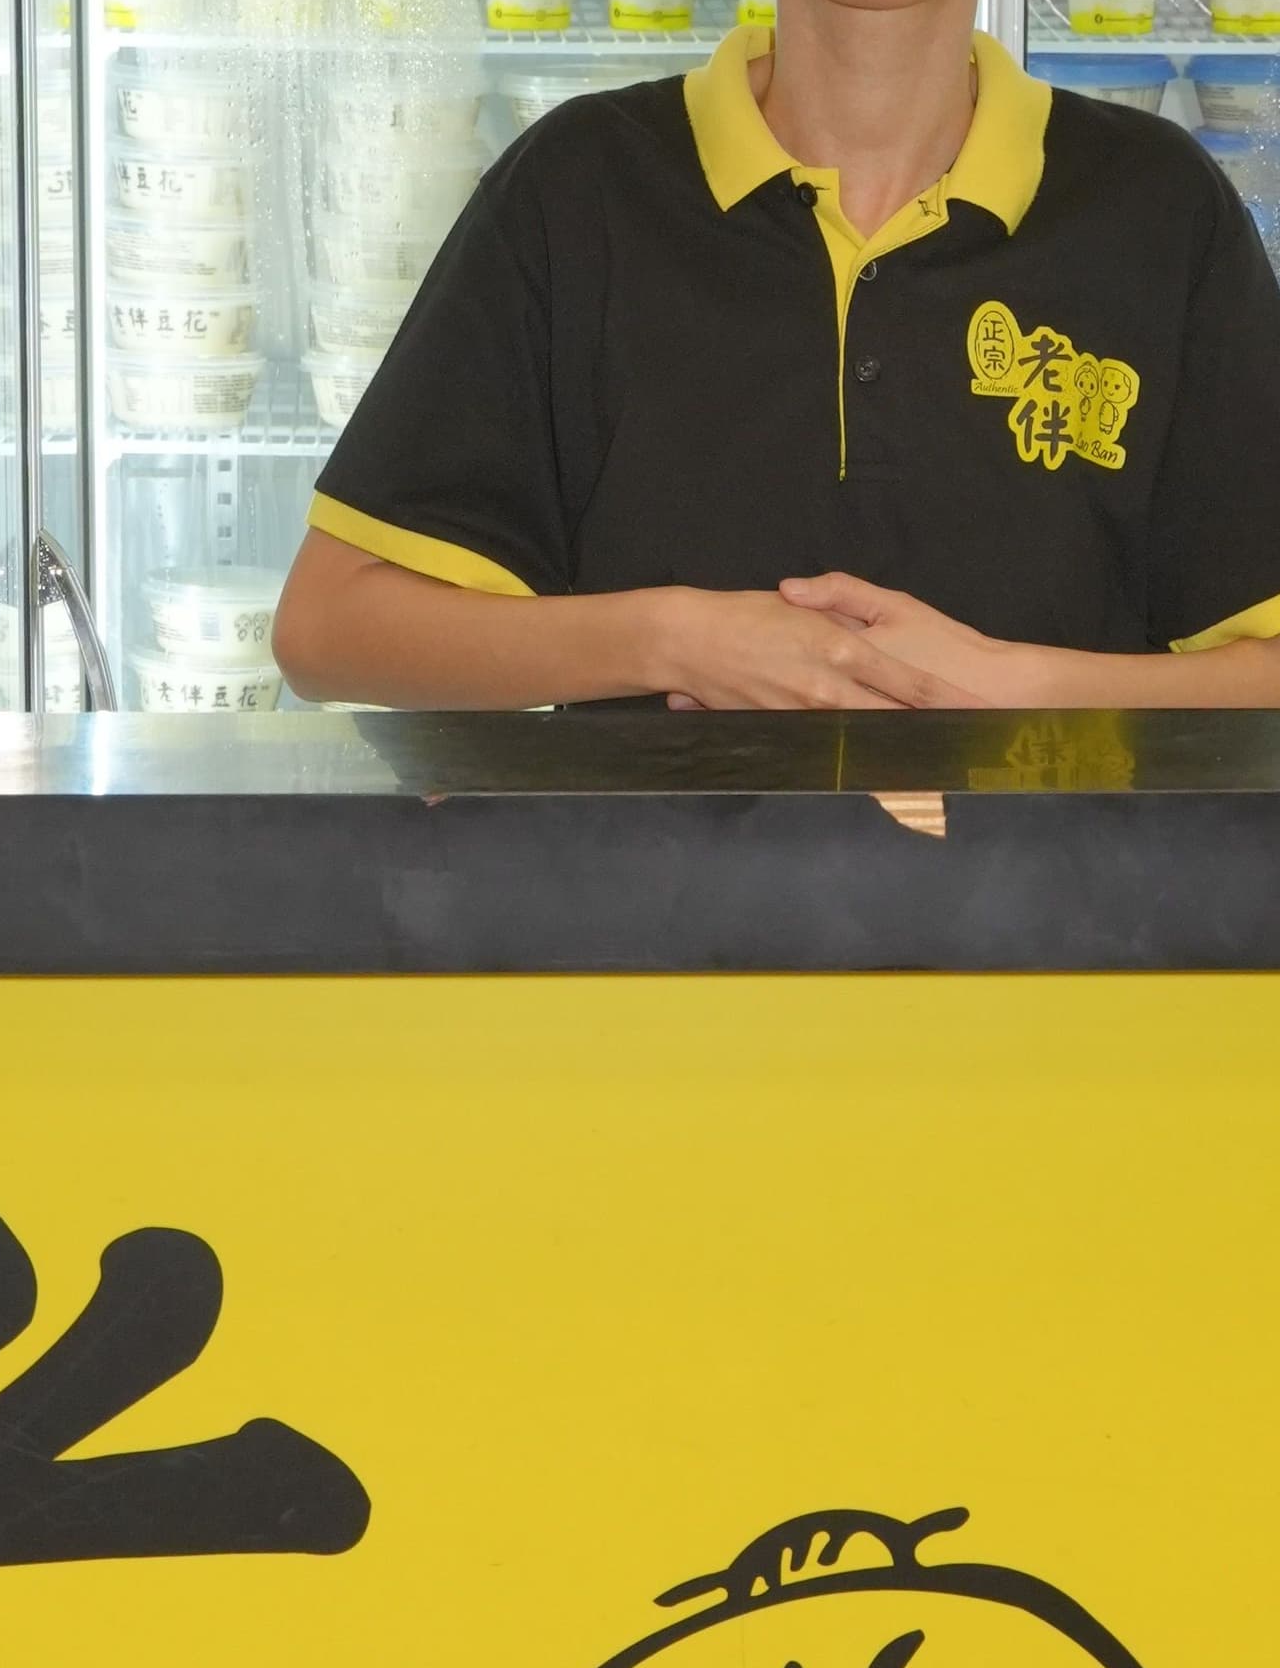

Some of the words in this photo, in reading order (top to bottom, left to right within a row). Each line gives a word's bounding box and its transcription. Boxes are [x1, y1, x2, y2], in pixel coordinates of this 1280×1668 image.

[982, 319, 1005, 371] 正宗
[974, 381, 1019, 394] Authentic
[1016, 334, 1074, 462] 老伴
[1090, 439, 1118, 463] Ban
